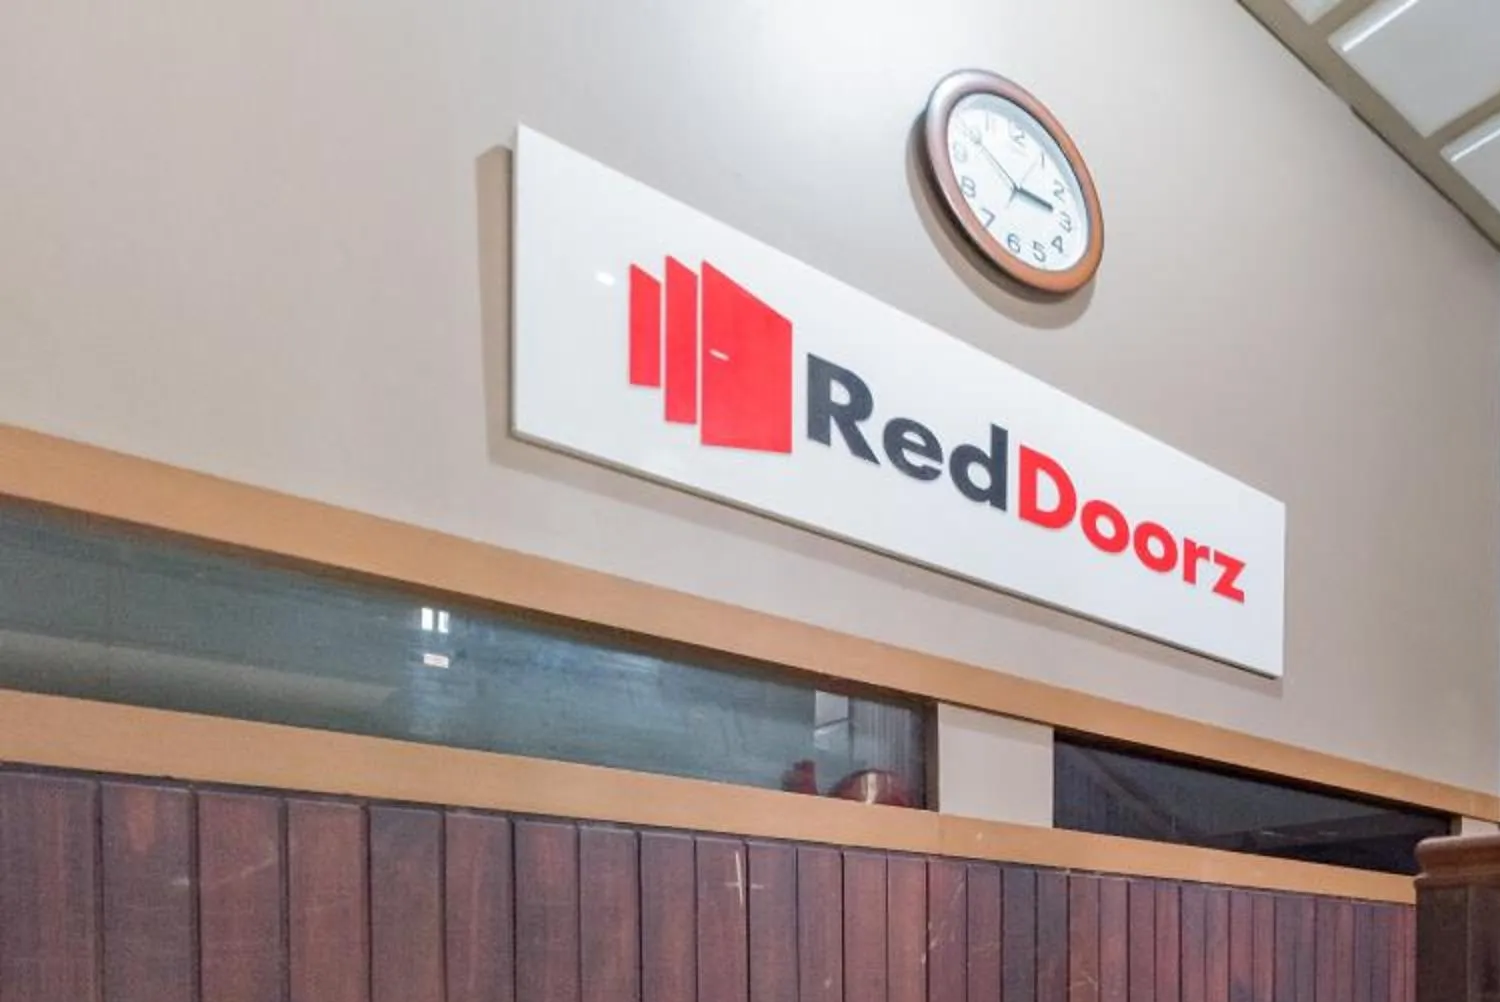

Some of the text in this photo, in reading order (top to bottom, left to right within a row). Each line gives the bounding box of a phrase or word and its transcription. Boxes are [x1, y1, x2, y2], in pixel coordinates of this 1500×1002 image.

[960, 174, 977, 199] 8
[1053, 179, 1065, 203] 2
[981, 206, 996, 231] 7
[1059, 211, 1073, 234] 3
[1007, 232, 1021, 254] 6
[1032, 239, 1047, 262] 5
[1050, 234, 1064, 254] 4
[807, 353, 1246, 604] RedDoorz
